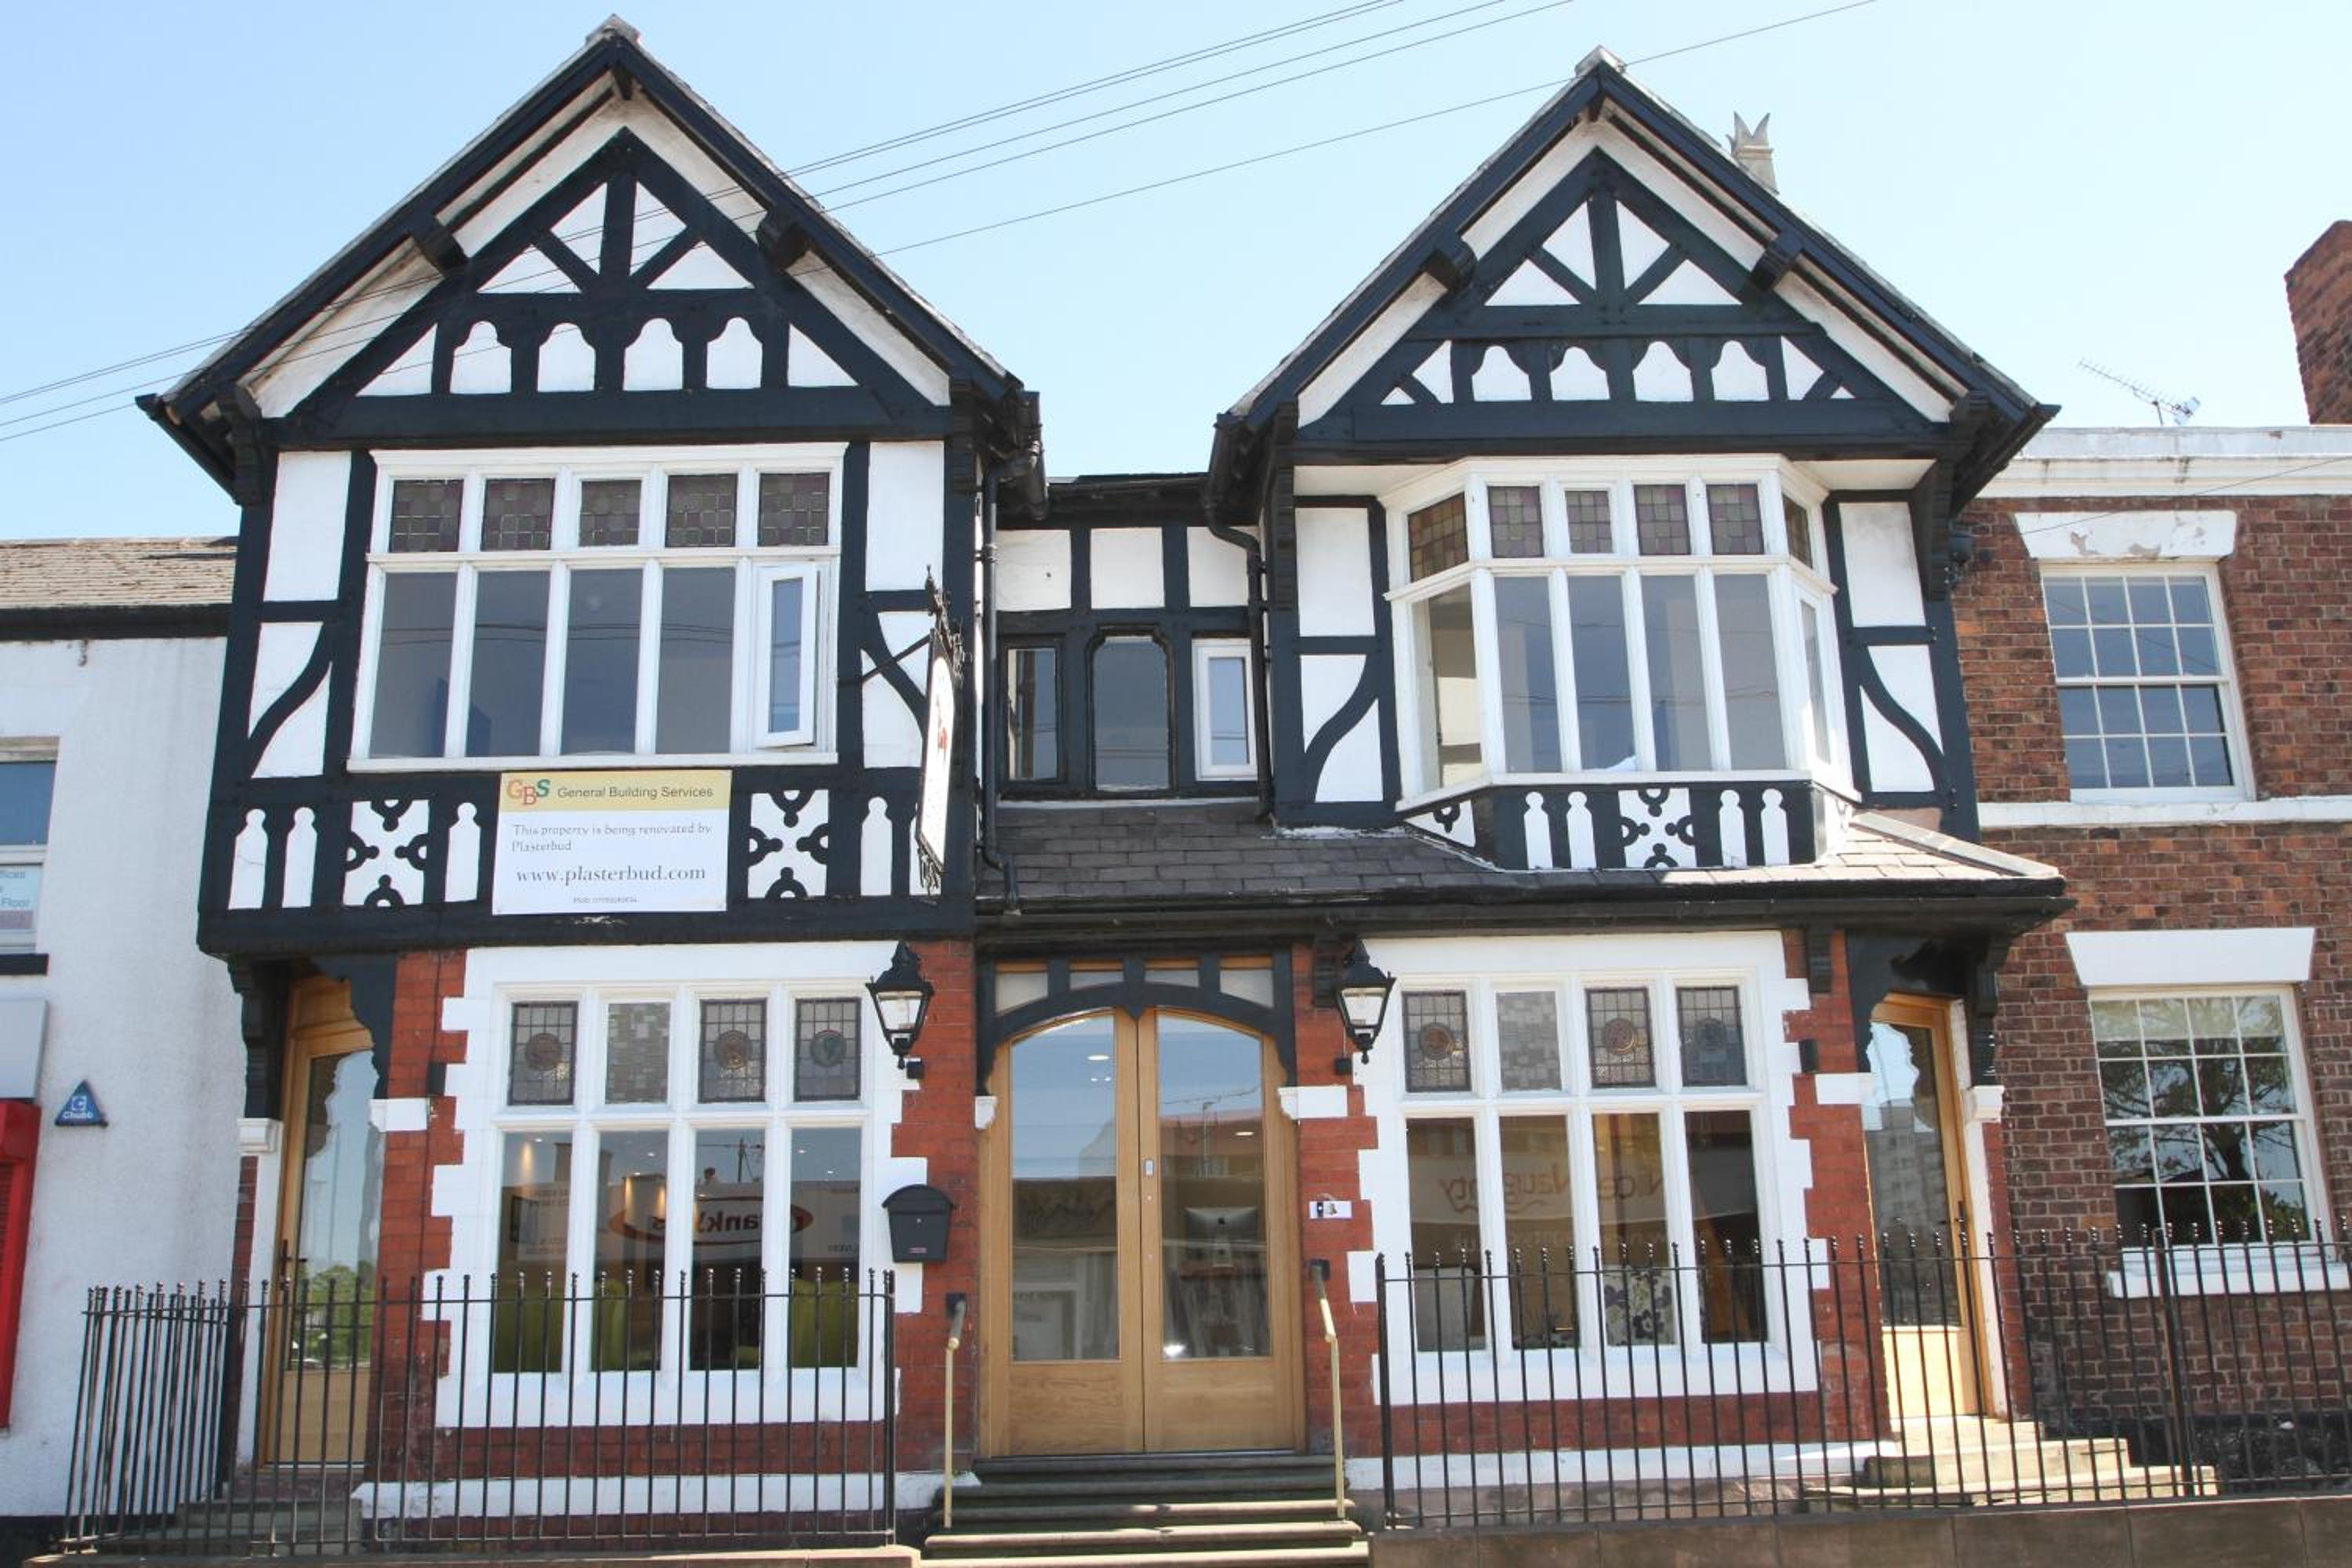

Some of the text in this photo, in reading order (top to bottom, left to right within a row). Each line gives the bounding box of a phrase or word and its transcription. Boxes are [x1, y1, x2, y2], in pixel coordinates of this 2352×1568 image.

[506, 779, 550, 805] GBS
[557, 786, 713, 800] General Building Services
[514, 822, 711, 837] This property is being renovated by
[511, 840, 572, 852] Plasterbud
[517, 865, 706, 886] www.plasterbud.com
[63, 1110, 94, 1120] Chubb
